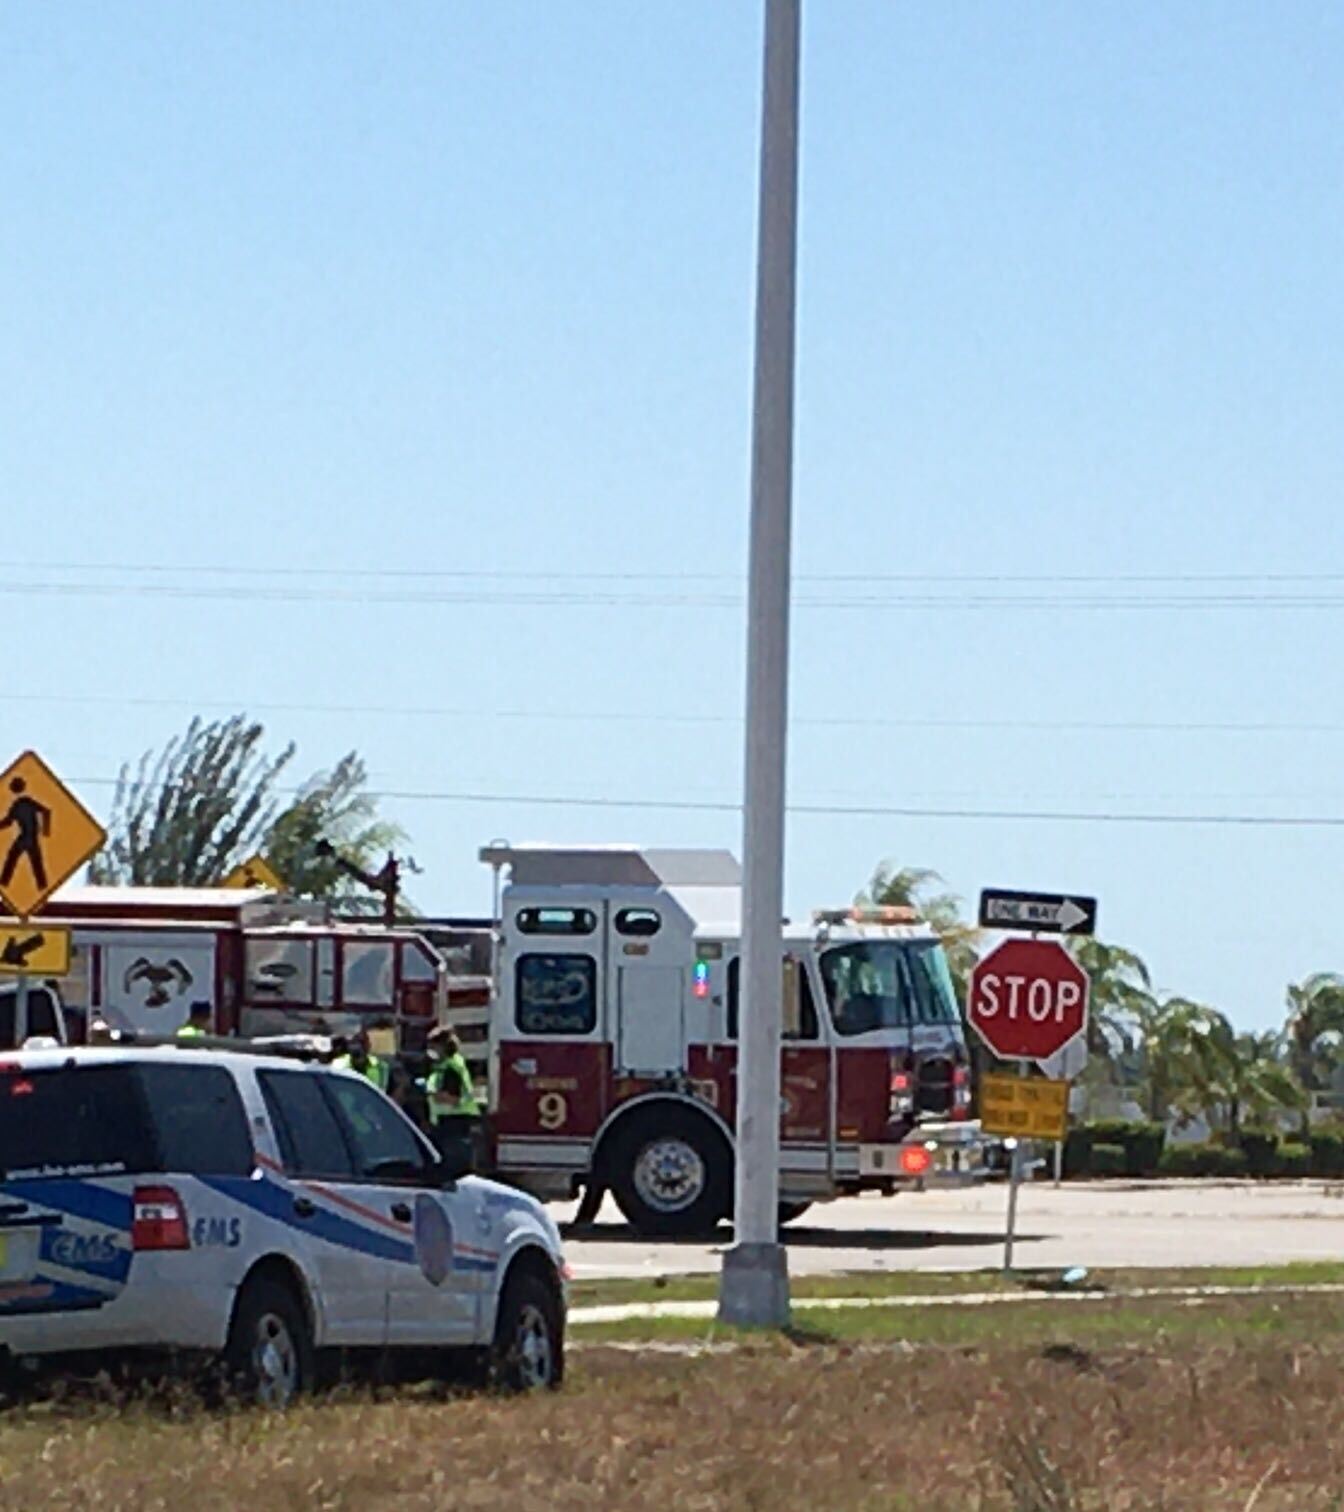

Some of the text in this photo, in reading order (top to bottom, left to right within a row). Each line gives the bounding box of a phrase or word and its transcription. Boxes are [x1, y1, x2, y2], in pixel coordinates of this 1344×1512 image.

[977, 973, 1081, 1023] STOP
[537, 1092, 567, 1130] 9
[51, 1231, 121, 1264] EMS
[193, 1216, 241, 1248] EMS
